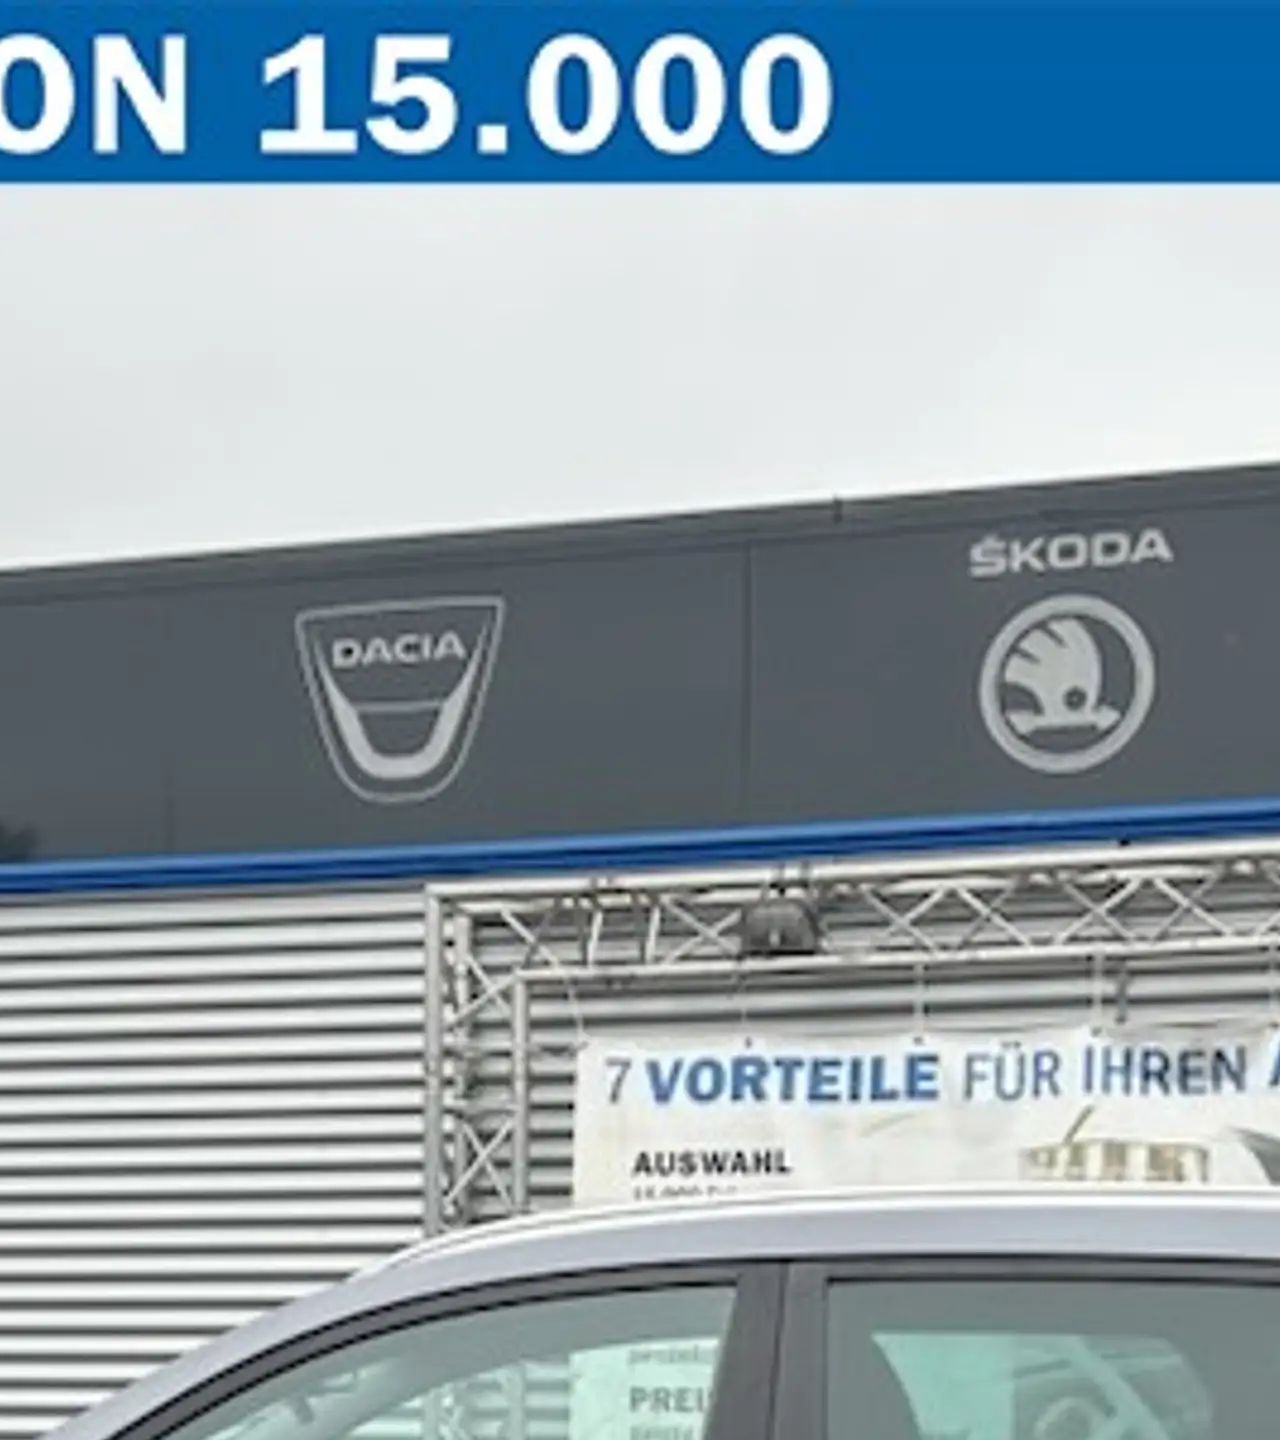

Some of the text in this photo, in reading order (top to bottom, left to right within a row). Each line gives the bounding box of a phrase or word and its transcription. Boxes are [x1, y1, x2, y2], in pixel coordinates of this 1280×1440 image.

[969, 528, 1174, 578] ŠKODA
[332, 630, 467, 669] DACIA
[604, 1058, 632, 1105] 7
[645, 1053, 940, 1104] VORTEILE
[963, 1040, 1062, 1101] FÜR
[1081, 1044, 1248, 1098] IHREN
[632, 1150, 793, 1177] AUSWAHL
